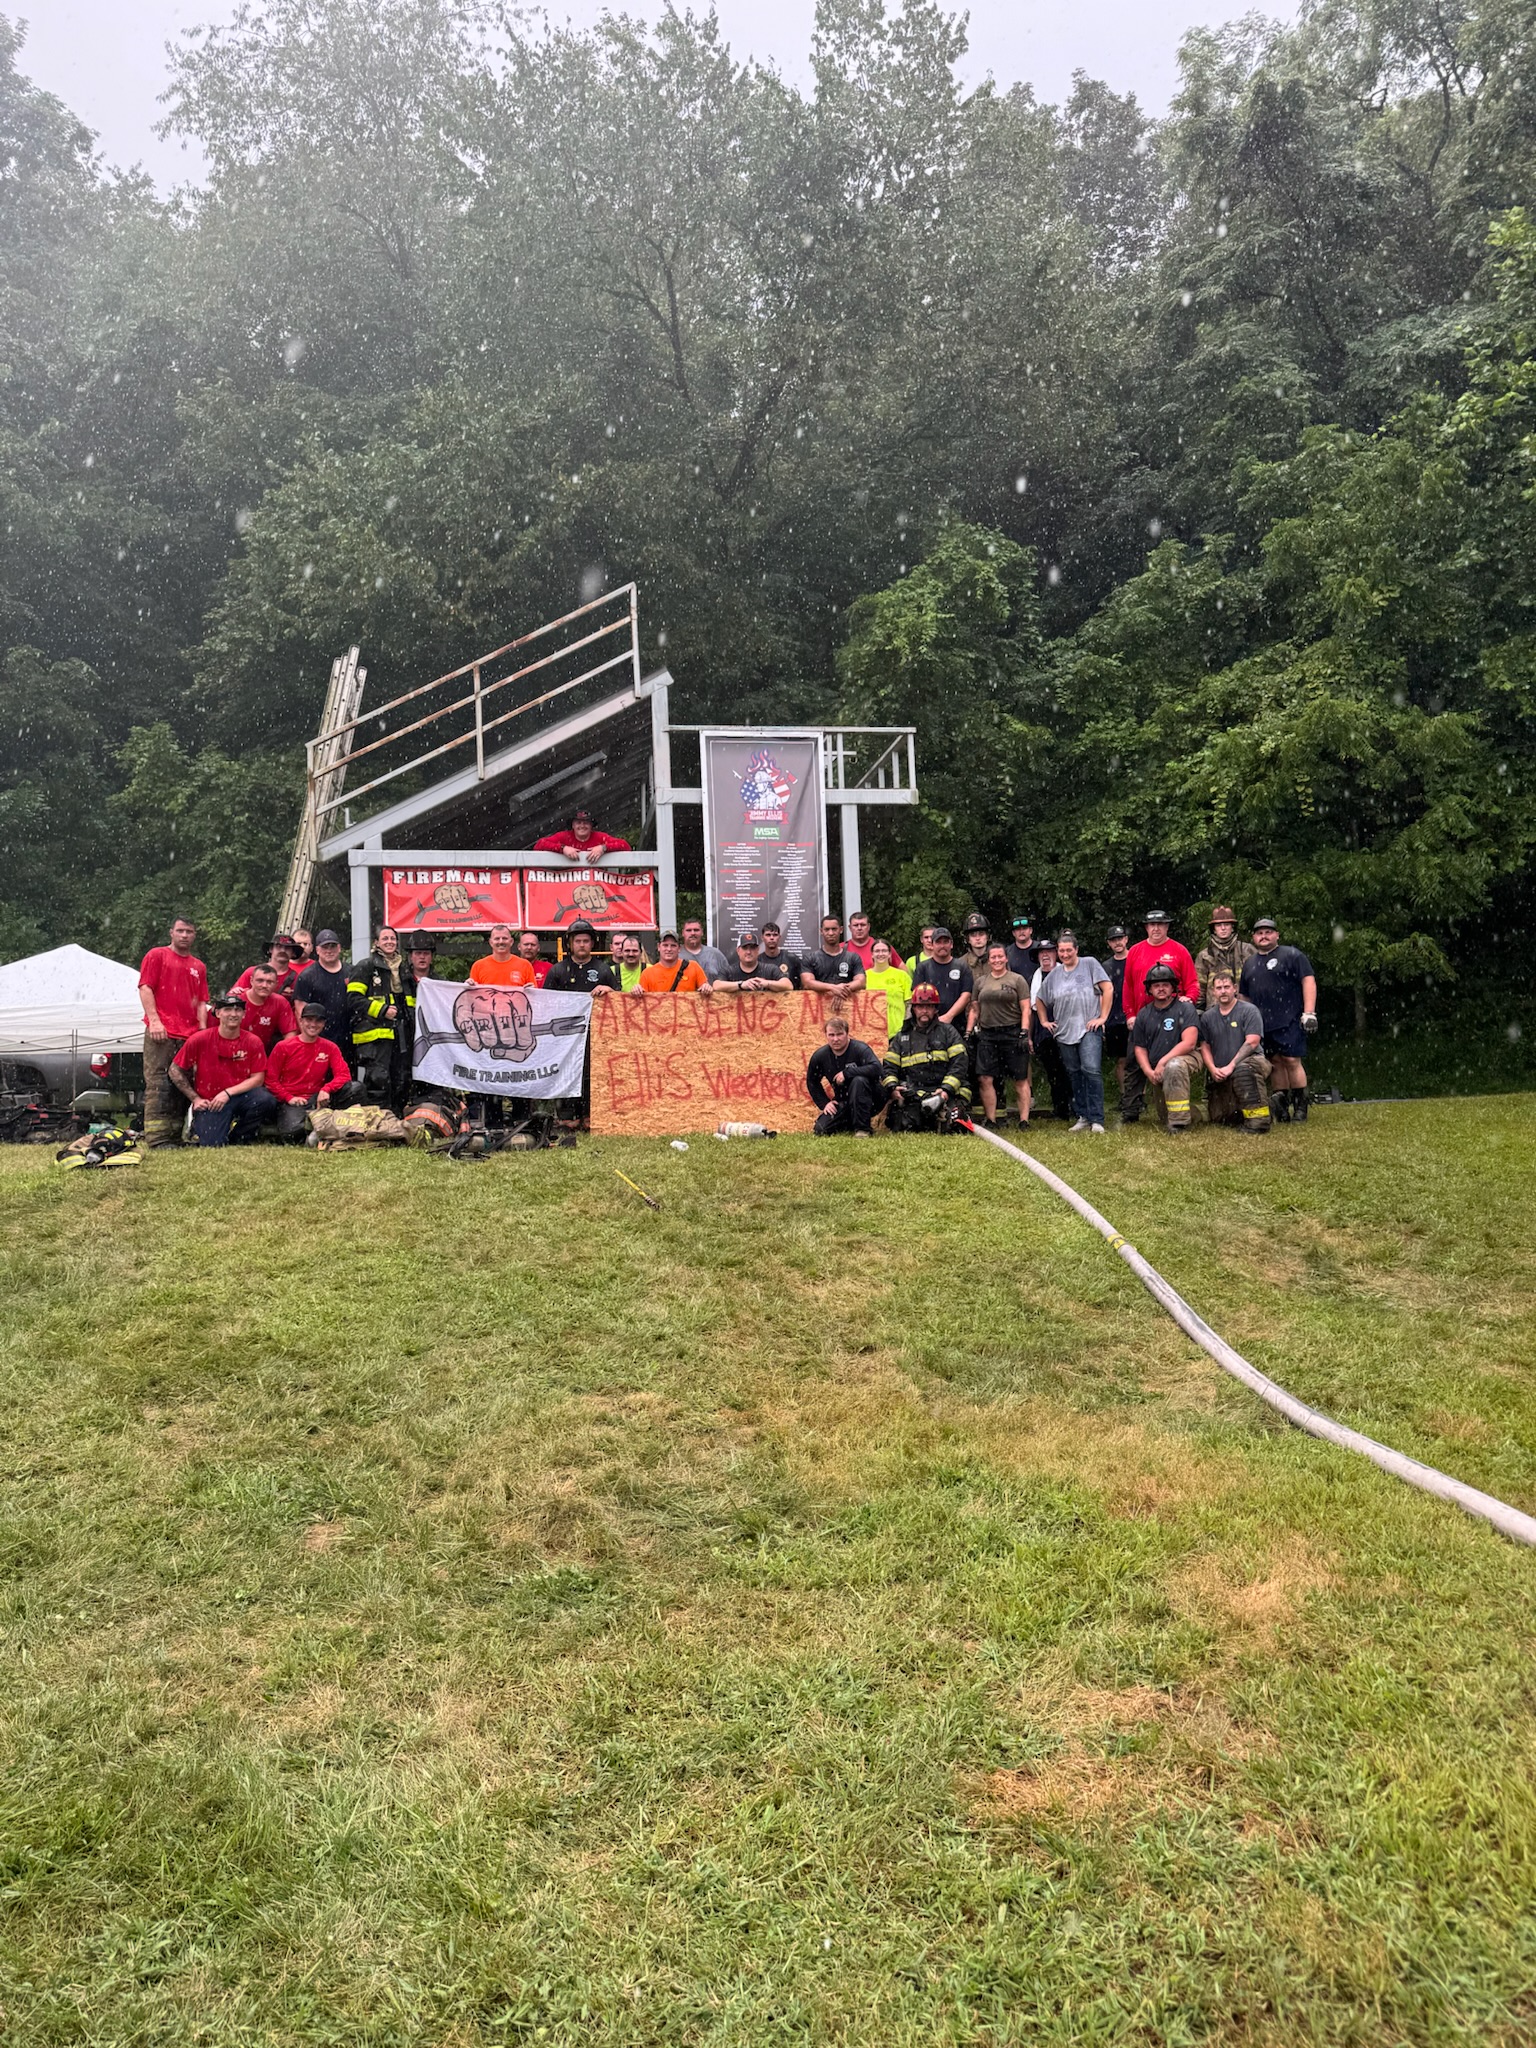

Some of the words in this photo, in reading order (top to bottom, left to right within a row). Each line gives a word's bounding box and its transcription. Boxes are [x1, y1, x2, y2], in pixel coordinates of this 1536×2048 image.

[754, 827, 779, 836] MSA
[391, 869, 492, 885] FIREMAN
[499, 871, 513, 885] 5
[527, 869, 591, 883] ARRIVING
[593, 870, 651, 886] MINUTES
[799, 990, 888, 1033] MNS
[452, 1063, 477, 1080] FIRE
[479, 1069, 538, 1083] TRAINING
[538, 1063, 560, 1079] LLC
